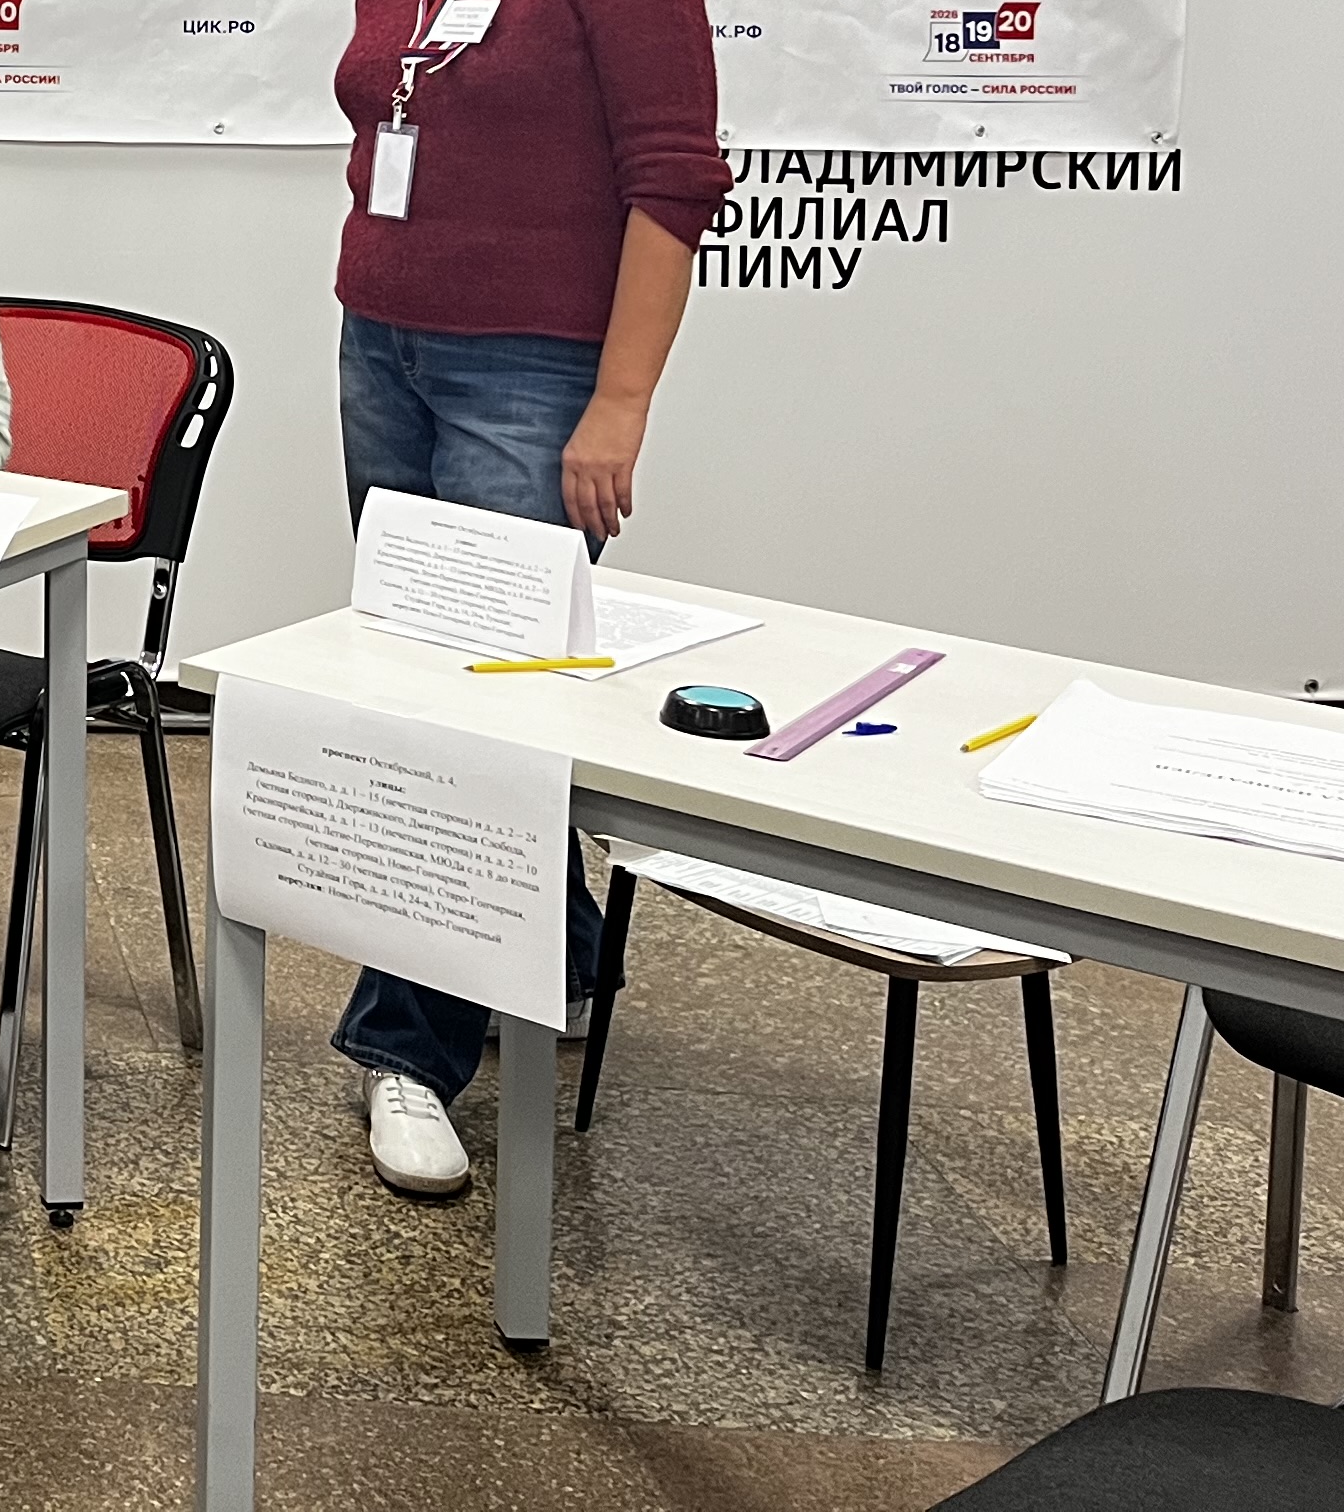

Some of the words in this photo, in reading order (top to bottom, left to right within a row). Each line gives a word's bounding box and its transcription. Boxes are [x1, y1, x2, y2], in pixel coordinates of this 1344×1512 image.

[182, 19, 255, 35] ЦИК.РФ
[935, 33, 960, 53] 18
[966, 21, 992, 42] 19
[998, 11, 1031, 31] 20
[969, 54, 1034, 62] СЕНТЯБРЯ
[890, 82, 922, 93] ТВОЙ
[926, 84, 968, 93] ГОЛОС
[982, 85, 1016, 94] СИЛА
[1021, 86, 1076, 94] РОССИИ!
[699, 245, 862, 289] ПИМУ
